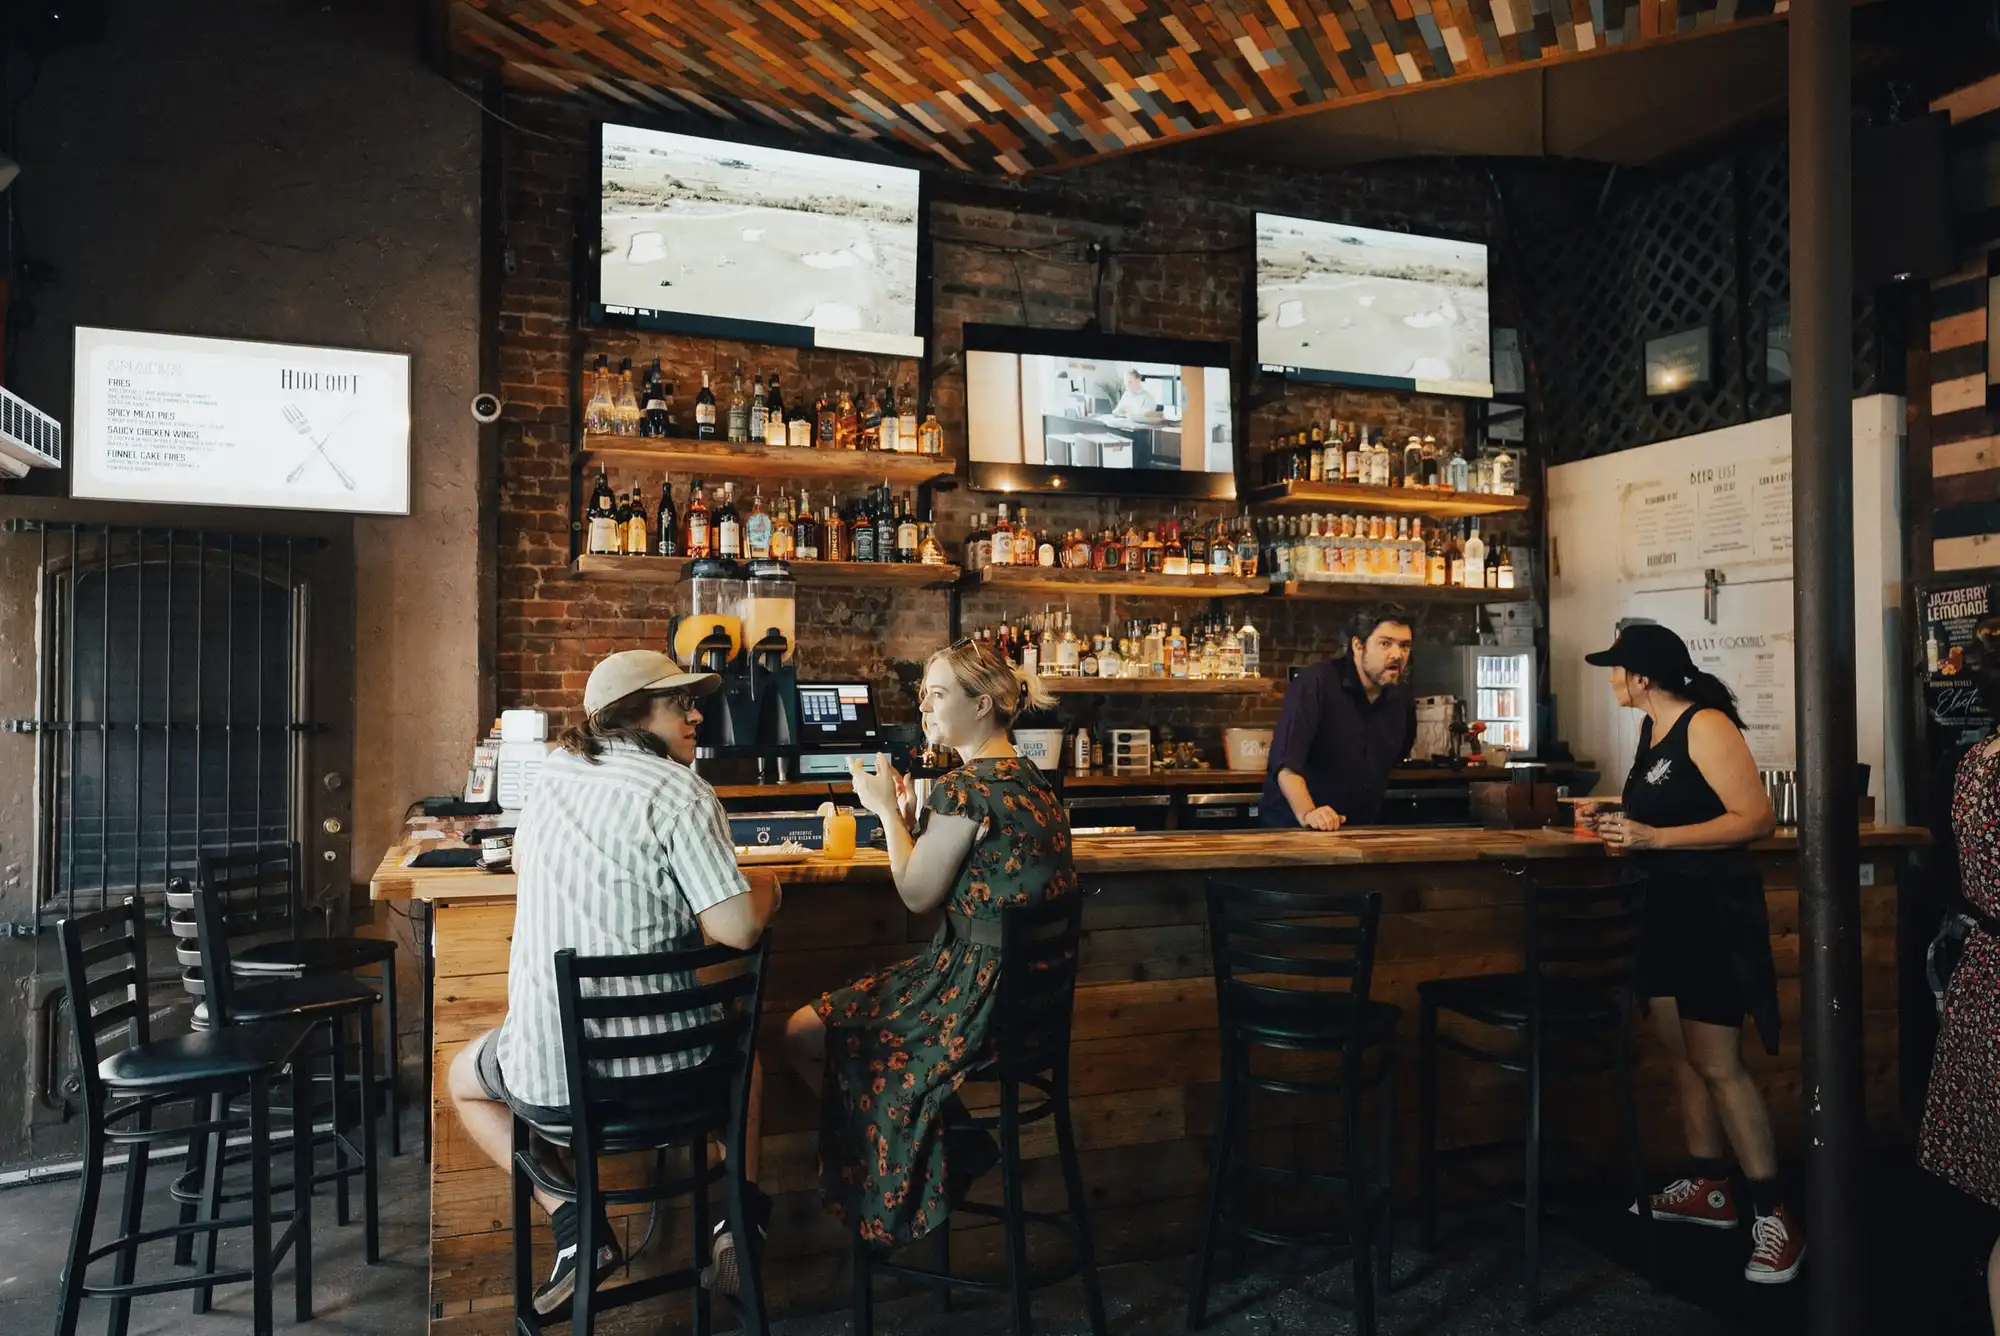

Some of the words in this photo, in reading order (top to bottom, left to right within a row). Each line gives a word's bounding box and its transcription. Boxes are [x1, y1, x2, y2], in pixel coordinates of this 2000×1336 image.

[108, 378, 131, 388] FRIES
[280, 368, 362, 395] HIDEOUT
[107, 408, 131, 417] SPICY
[133, 410, 155, 419] MEAT
[157, 411, 175, 420] PIES
[107, 426, 134, 435] SAUCY
[136, 427, 170, 438] CHICKEN
[172, 430, 199, 440] WINGS
[107, 450, 137, 459] FUNNEL
[140, 451, 161, 461] CAKE
[164, 453, 186, 462] FRIES
[1690, 469, 1713, 485] BEER
[1718, 464, 1736, 480] LIST
[1926, 585, 1988, 608] JAZZBERRY
[1927, 600, 1989, 622] LEMONADE
[757, 831, 770, 844] Q
